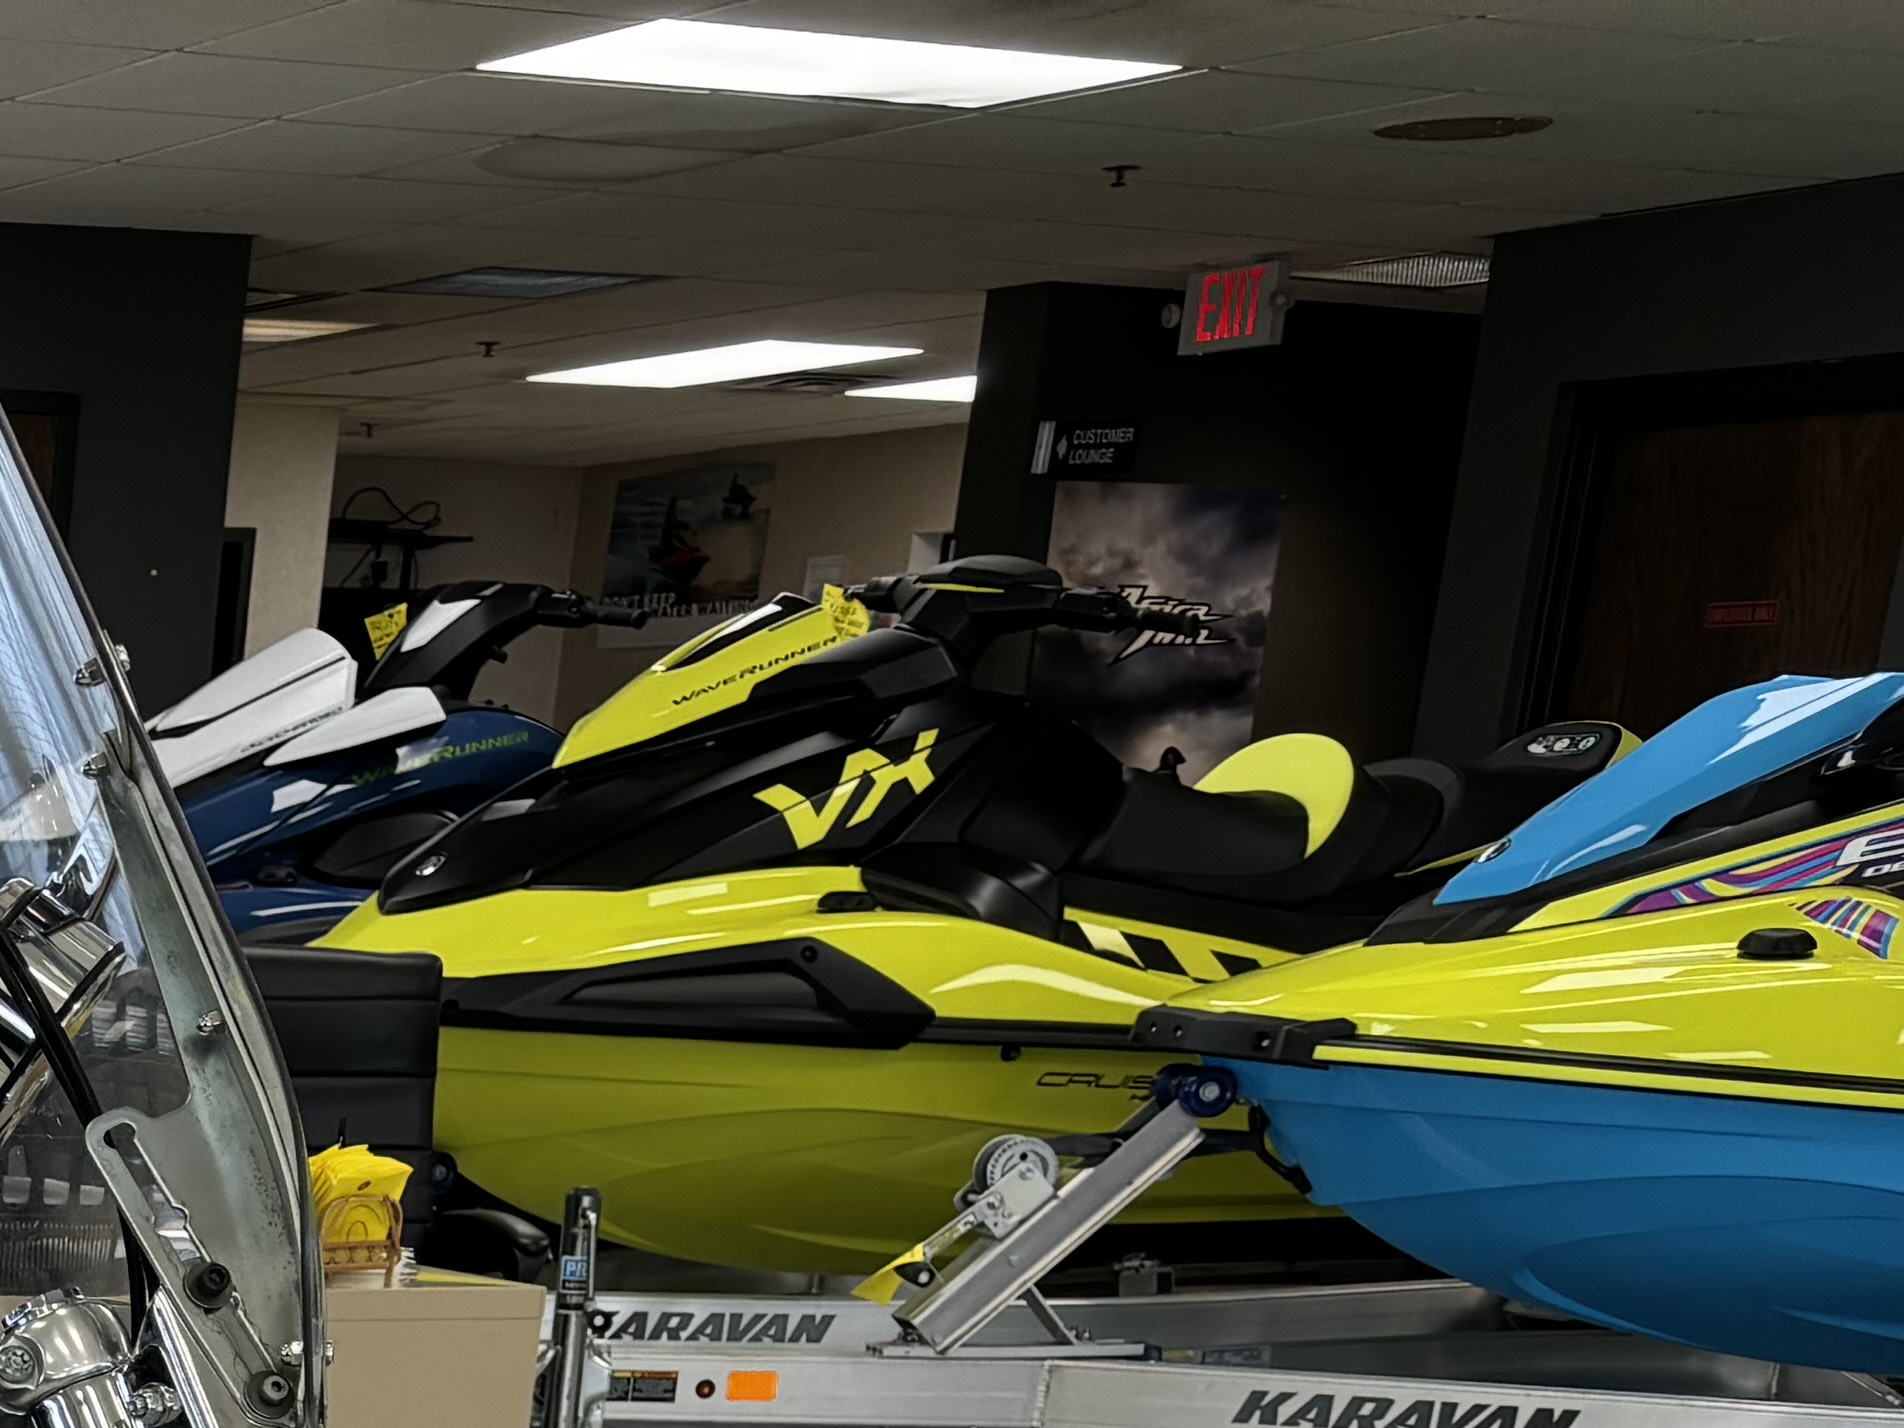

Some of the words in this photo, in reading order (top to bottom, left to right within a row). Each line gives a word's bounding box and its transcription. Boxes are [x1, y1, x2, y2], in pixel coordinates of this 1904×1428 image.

[1195, 266, 1266, 343] EXIT
[1073, 428, 1135, 444] CUSTOMER
[1069, 448, 1115, 464] LOUNGE
[672, 634, 838, 706] WAVERUNNER
[587, 1310, 837, 1344] ARAVAN
